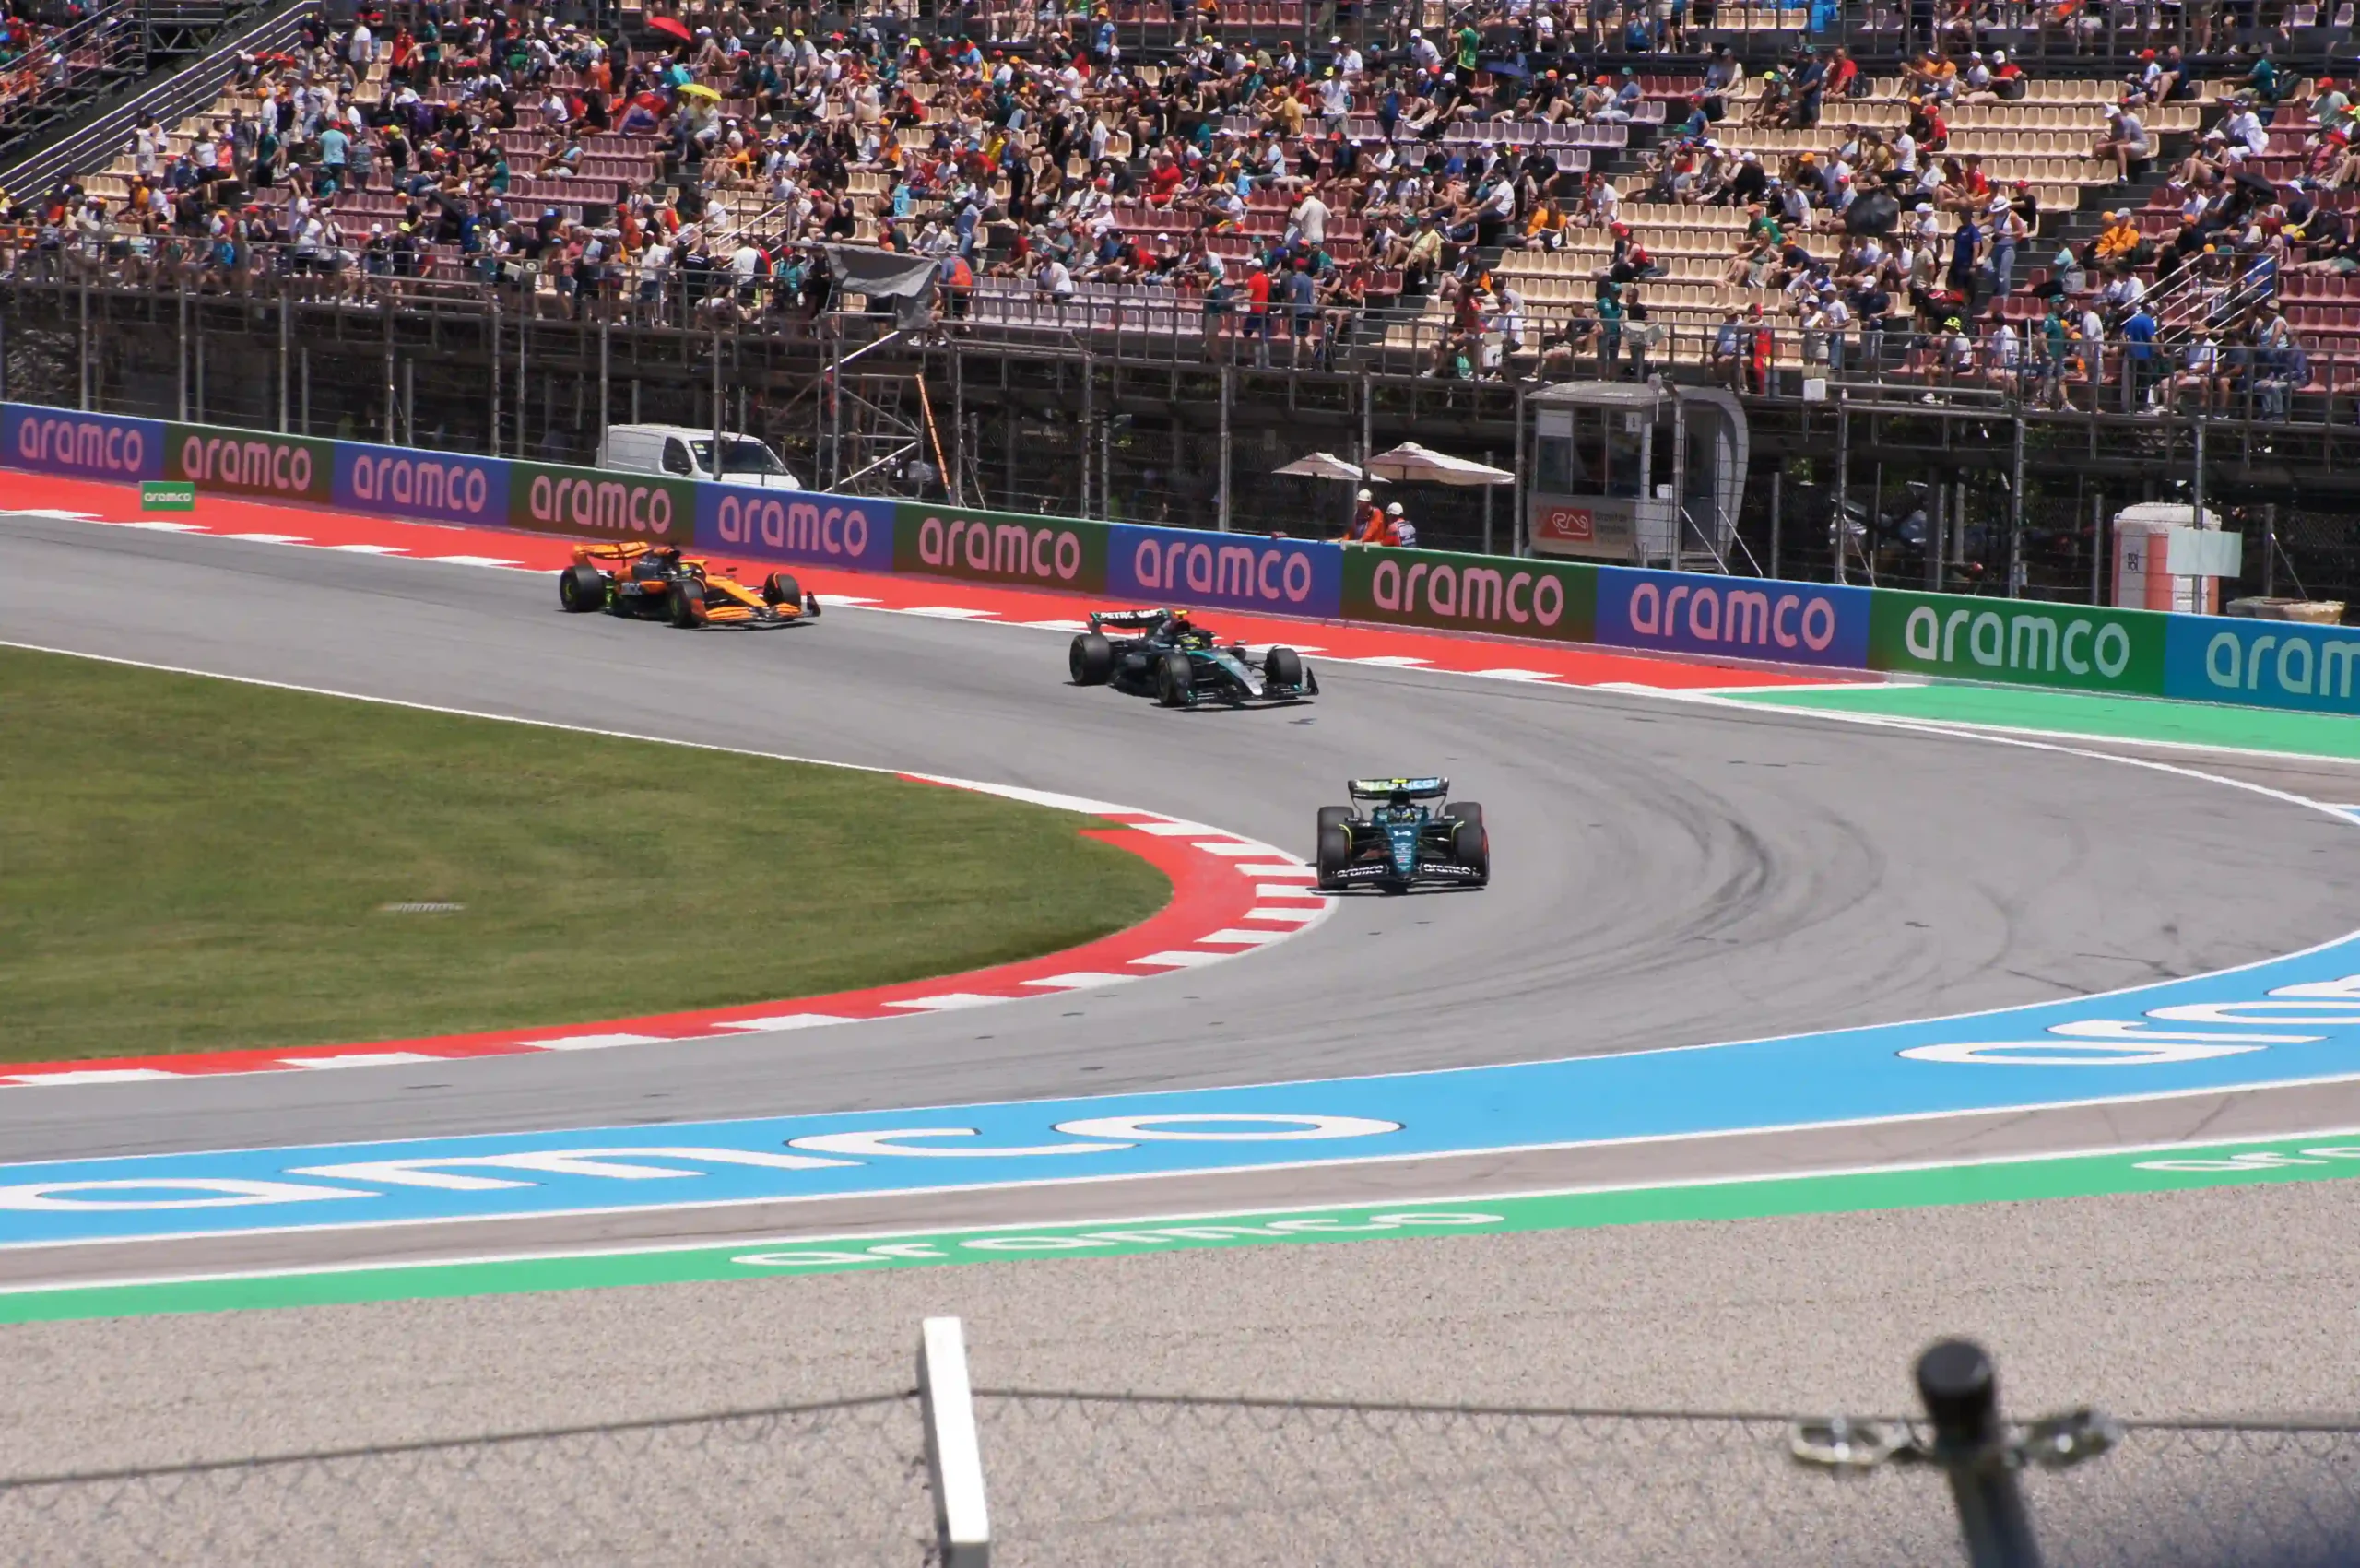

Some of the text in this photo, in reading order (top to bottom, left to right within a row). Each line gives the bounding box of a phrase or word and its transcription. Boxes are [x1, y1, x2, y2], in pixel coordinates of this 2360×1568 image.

[19, 416, 143, 472] aramco
[182, 435, 312, 492] aramco
[143, 491, 193, 502] aramco
[352, 454, 487, 513] aramco
[529, 474, 672, 535] aramco
[717, 494, 868, 558] aramco
[918, 516, 1081, 581] aramco
[1134, 538, 1312, 603] aramco
[1372, 560, 1564, 627] aramco
[1629, 582, 1835, 652] aramco
[1905, 606, 2130, 678] aramco
[729, 1211, 1505, 1267] aramco
